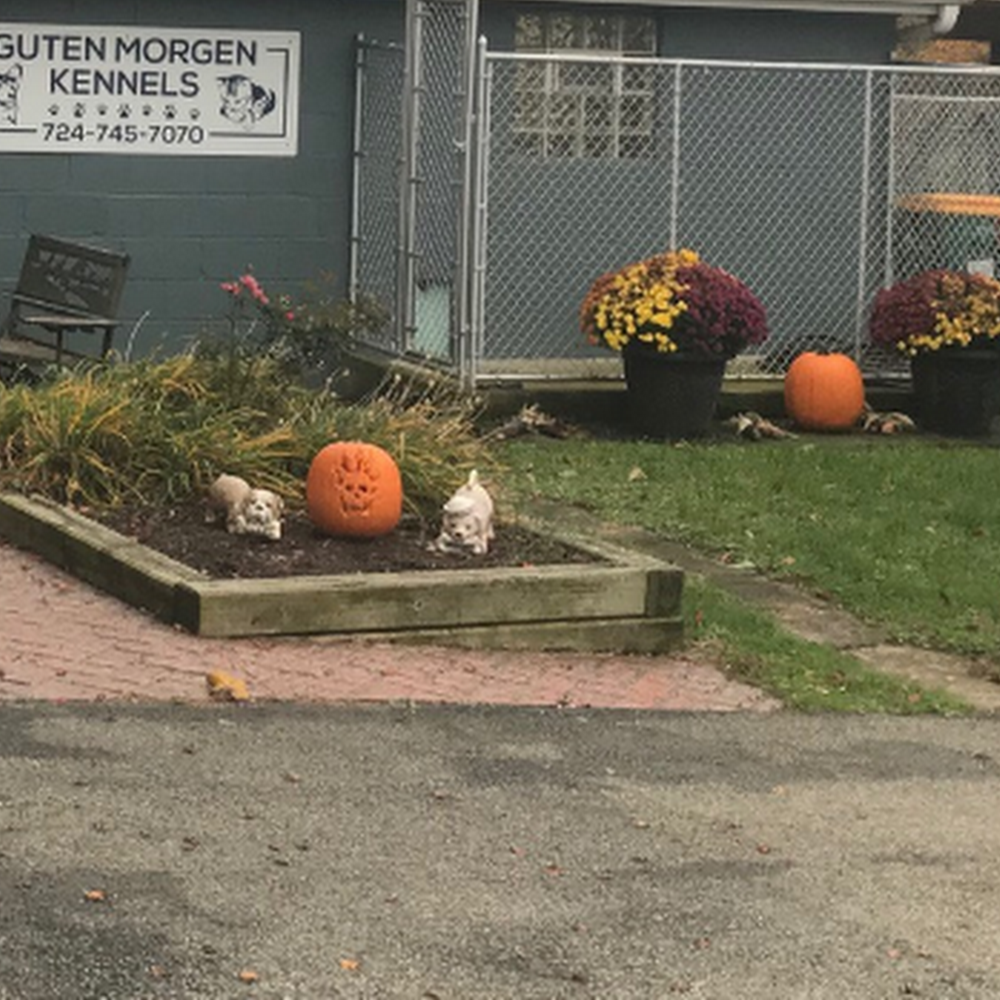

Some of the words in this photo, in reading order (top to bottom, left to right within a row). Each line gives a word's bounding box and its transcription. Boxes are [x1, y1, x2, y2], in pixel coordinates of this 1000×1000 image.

[115, 37, 257, 65] MORGEN
[50, 68, 200, 97] KENNELS
[42, 123, 204, 144] 724-745-7070
